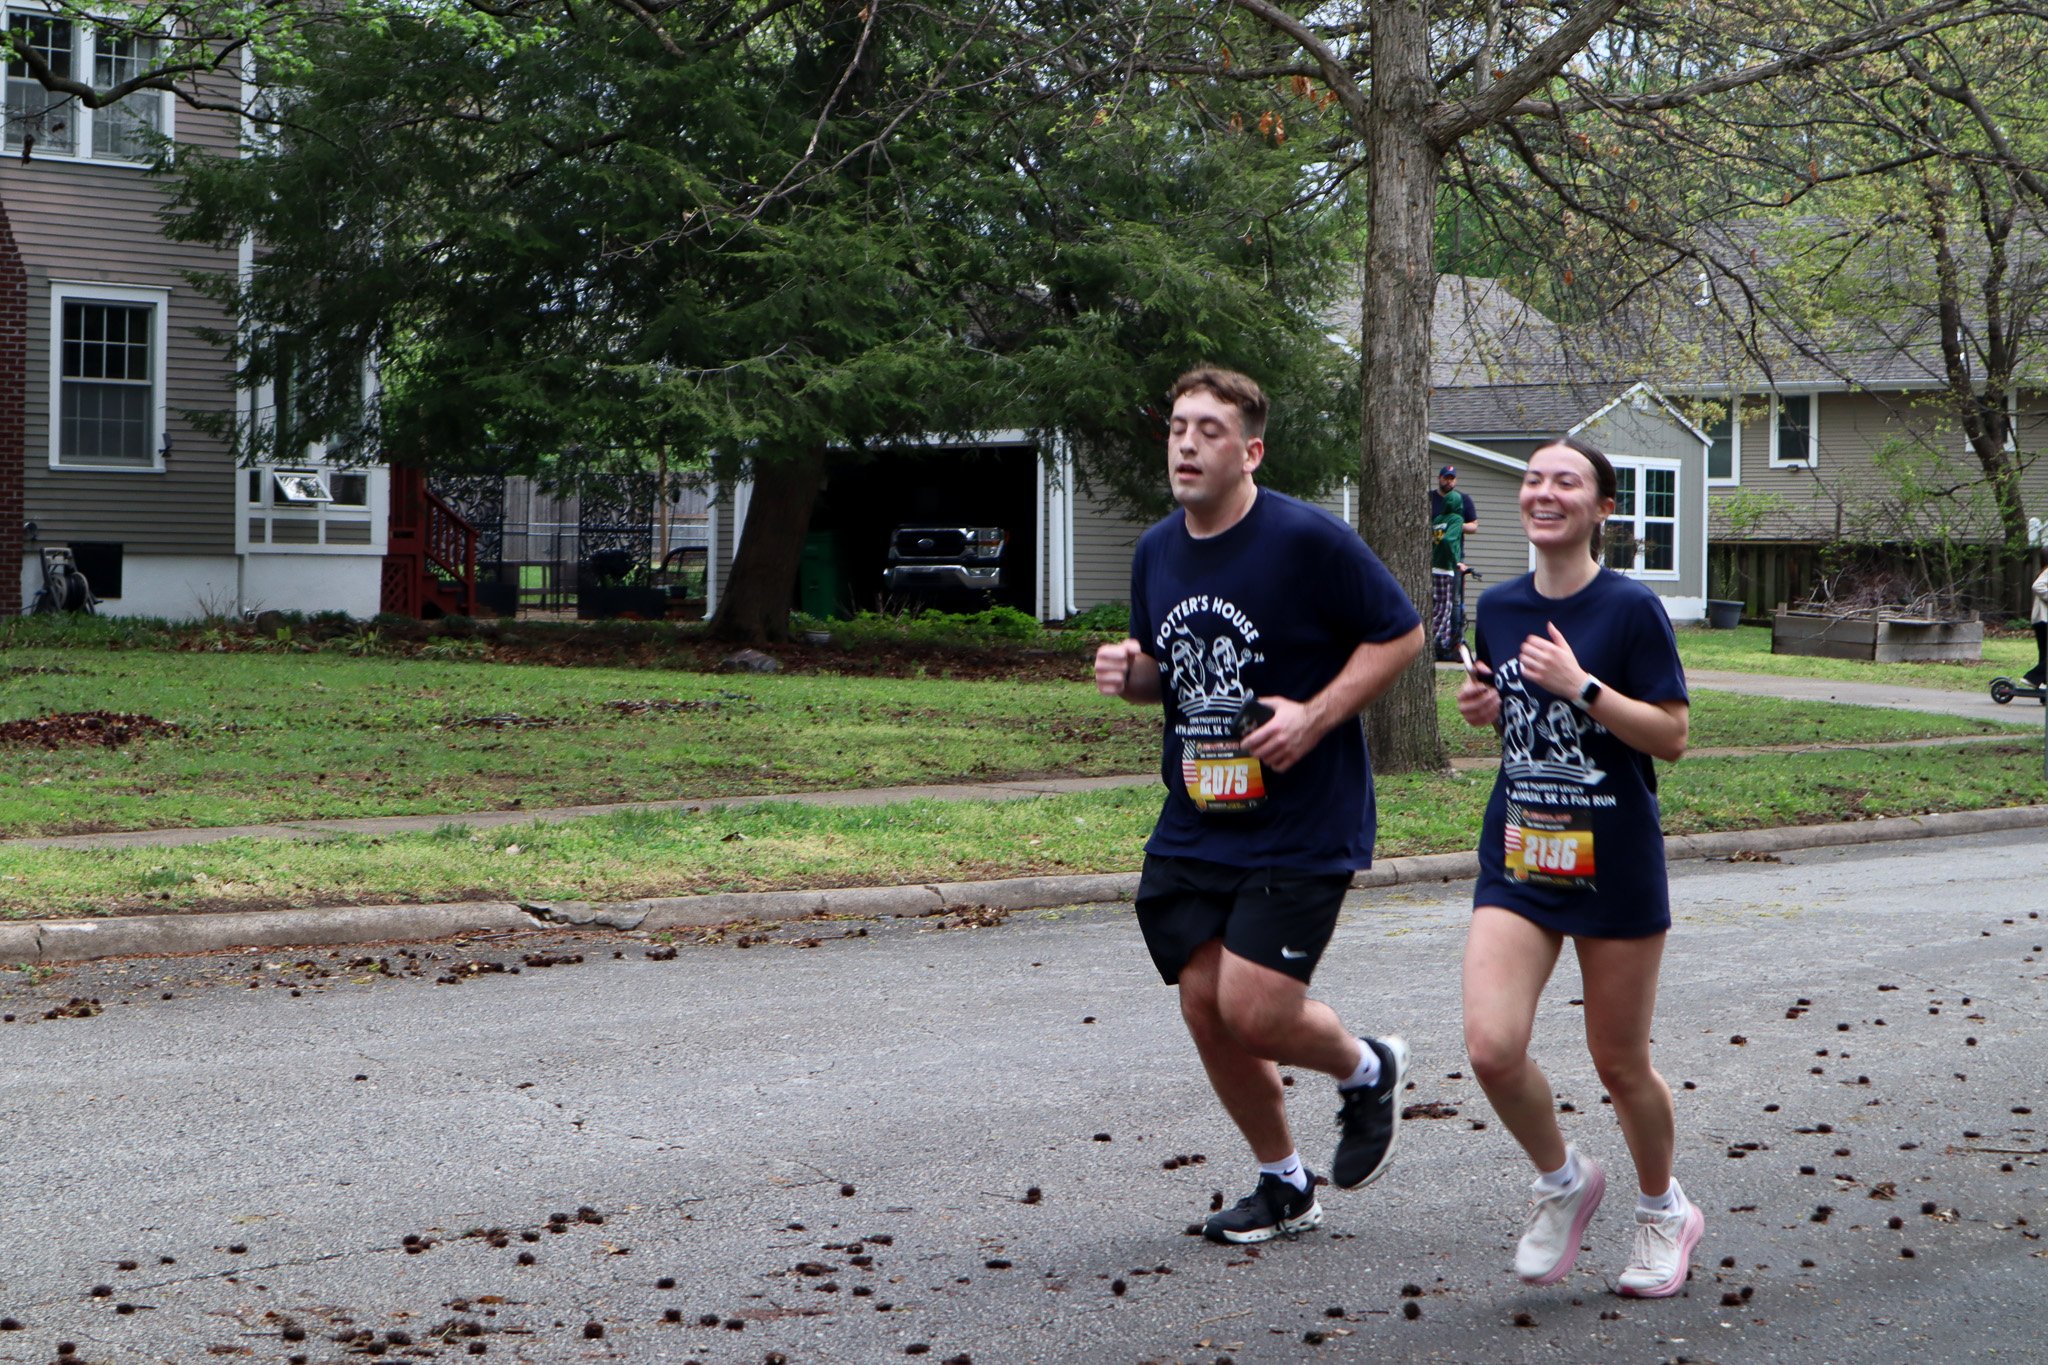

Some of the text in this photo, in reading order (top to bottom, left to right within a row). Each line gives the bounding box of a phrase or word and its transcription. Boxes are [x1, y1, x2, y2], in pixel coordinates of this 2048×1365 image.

[1157, 595, 1259, 649] POTTER'S HOUSE
[1187, 725, 1212, 735] ANNUAL
[1212, 725, 1223, 735] 5K
[1200, 764, 1248, 795] 2075
[1570, 793, 1590, 806] FUN
[1592, 794, 1617, 807] RUN
[1524, 835, 1578, 870] 2136
